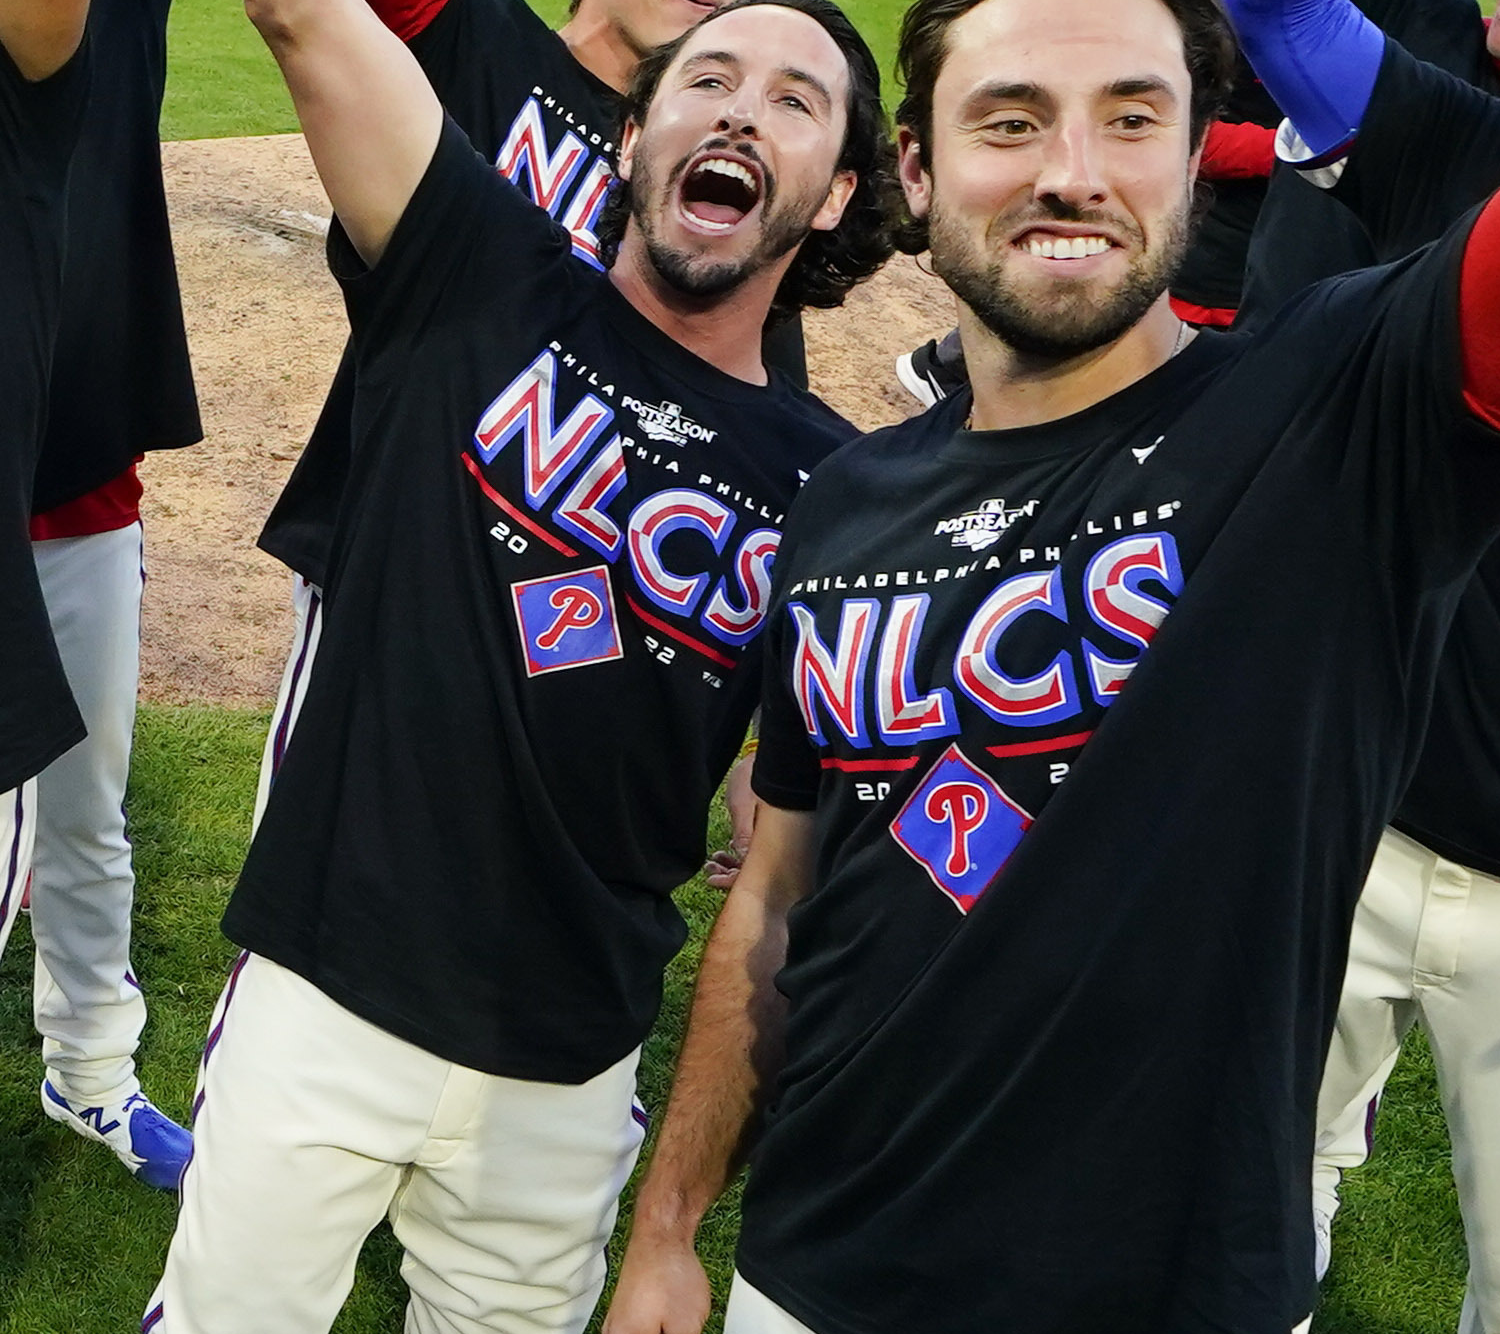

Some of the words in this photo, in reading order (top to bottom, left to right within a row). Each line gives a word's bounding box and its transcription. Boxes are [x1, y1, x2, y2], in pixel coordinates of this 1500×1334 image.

[621, 394, 717, 447] POSTSEASON
[473, 348, 785, 639] NLCS
[489, 519, 529, 556] 20
[536, 583, 604, 652] P
[787, 531, 1187, 750] NLCS
[924, 780, 990, 878] P
